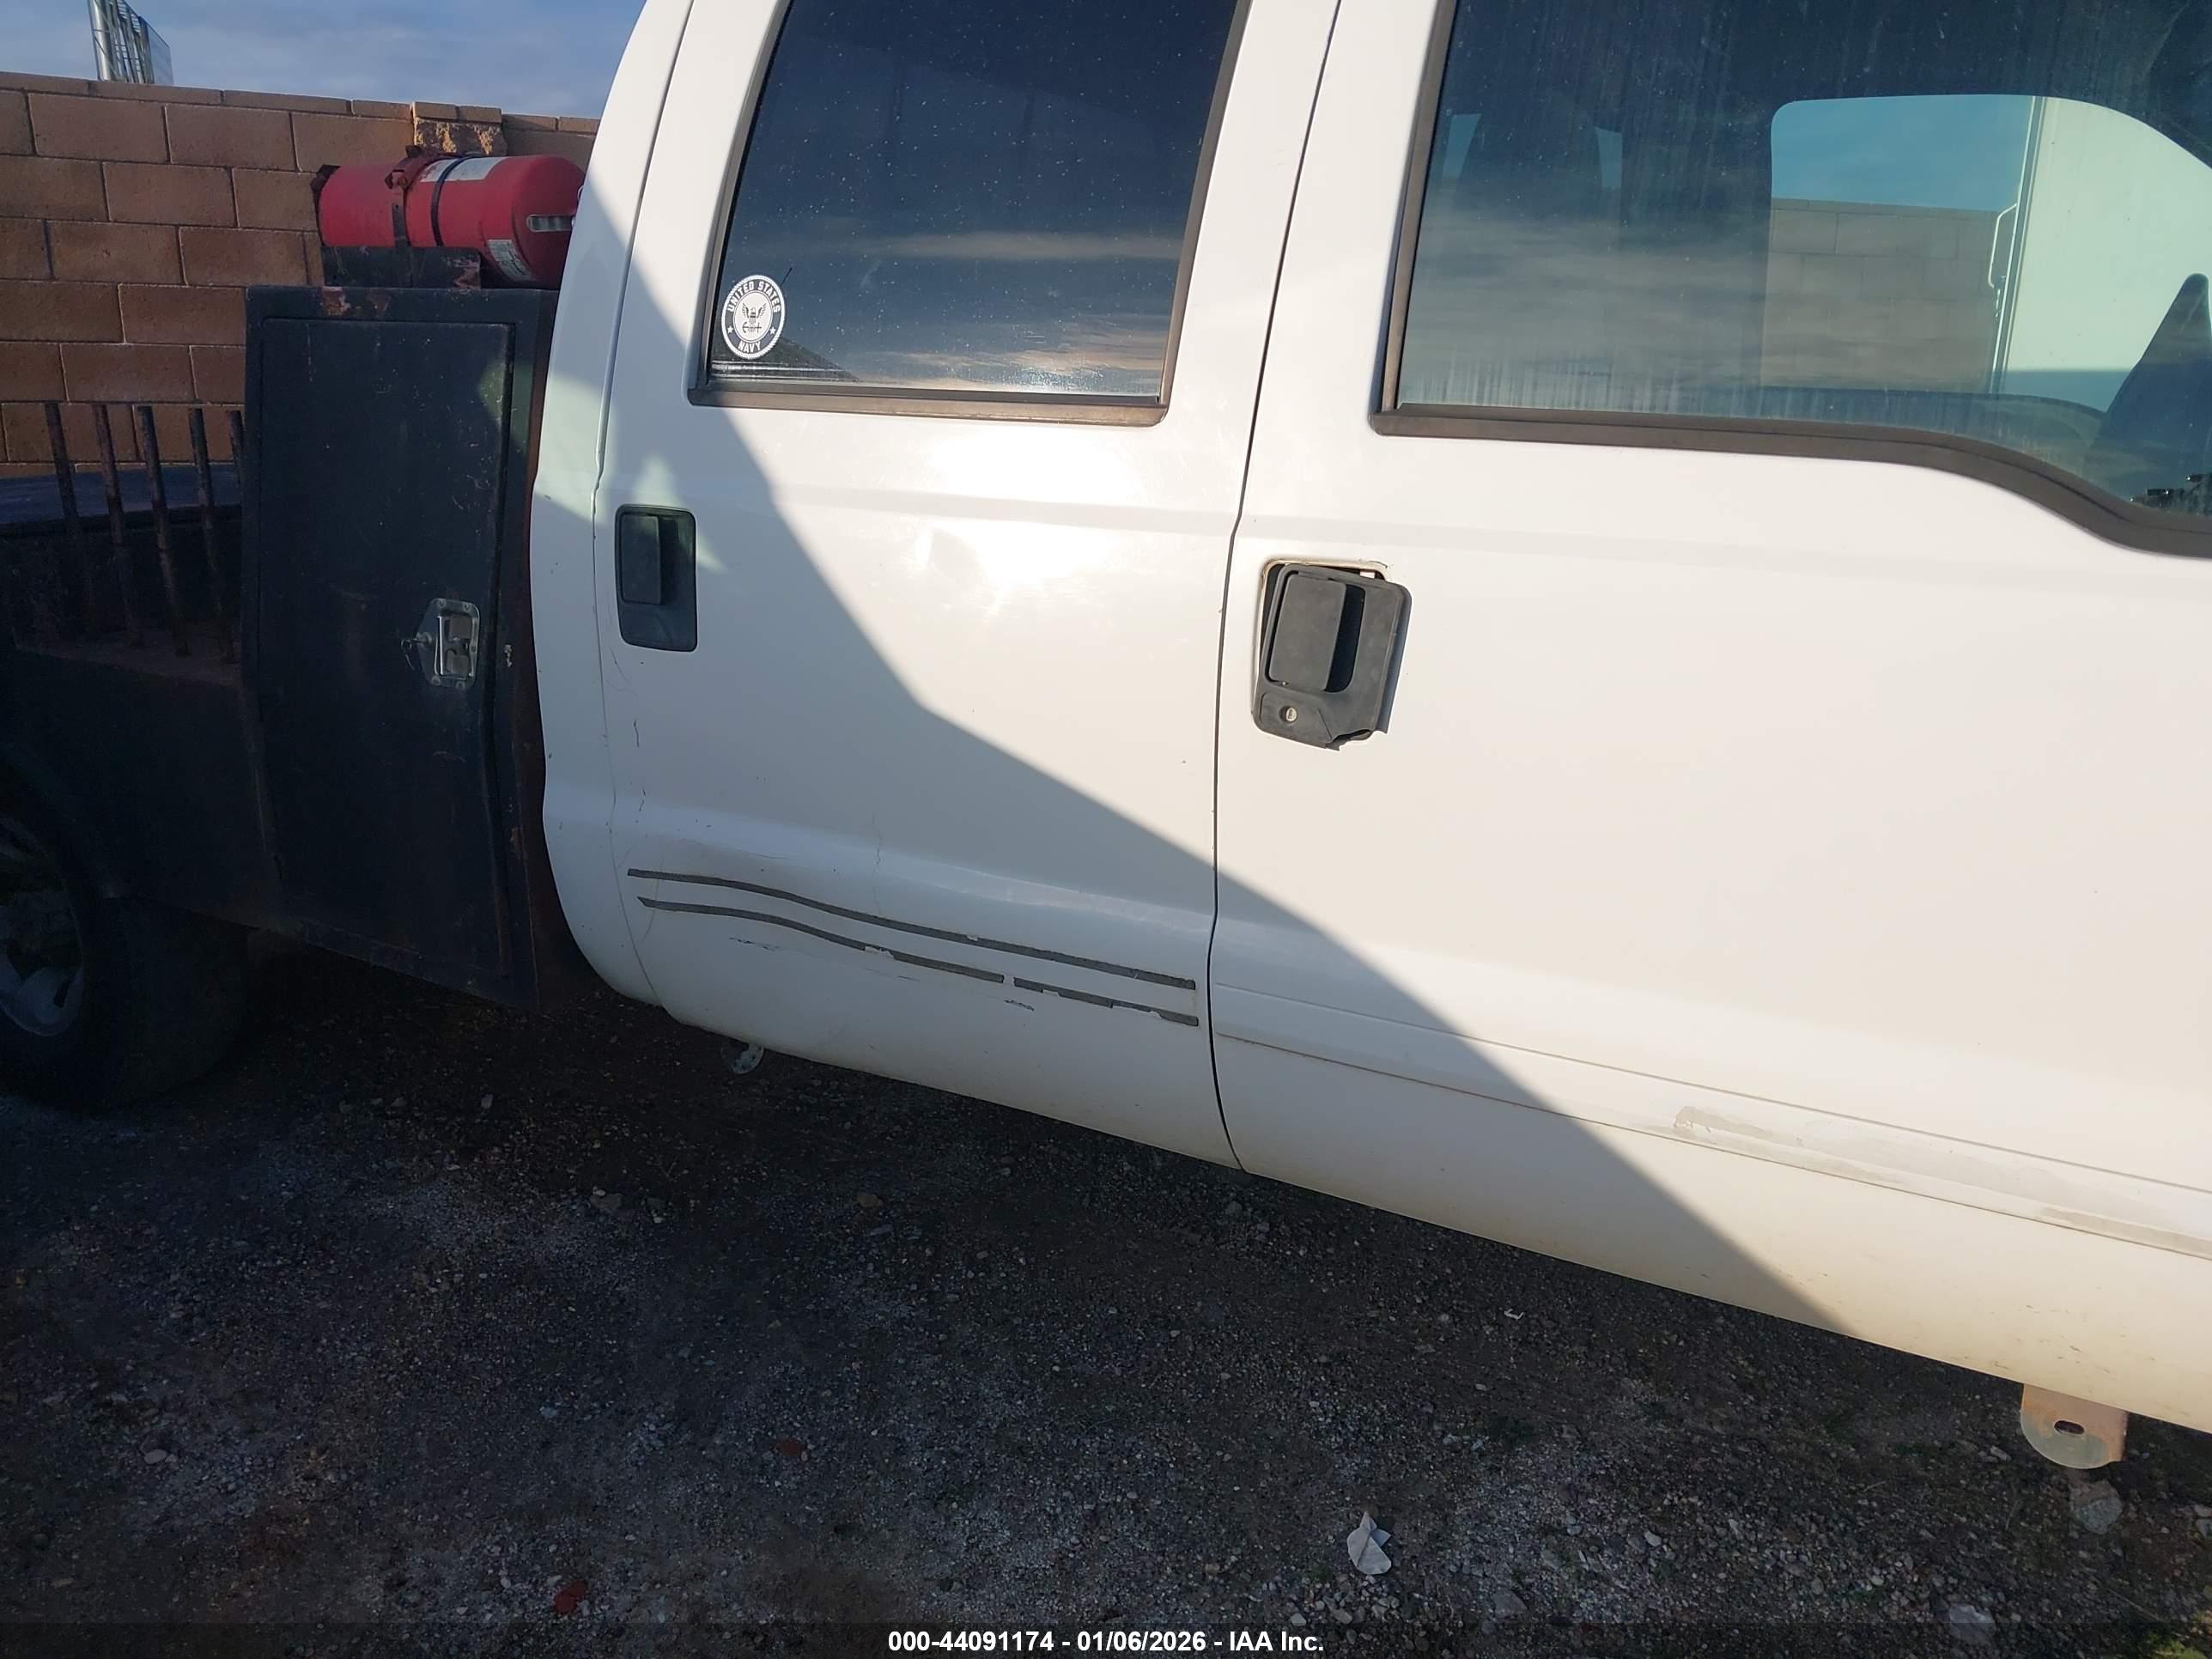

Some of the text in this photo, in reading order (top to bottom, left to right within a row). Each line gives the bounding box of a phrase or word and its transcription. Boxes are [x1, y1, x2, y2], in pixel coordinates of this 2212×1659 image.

[726, 280, 781, 313] UNITED STATES
[738, 340, 761, 353] NAVY
